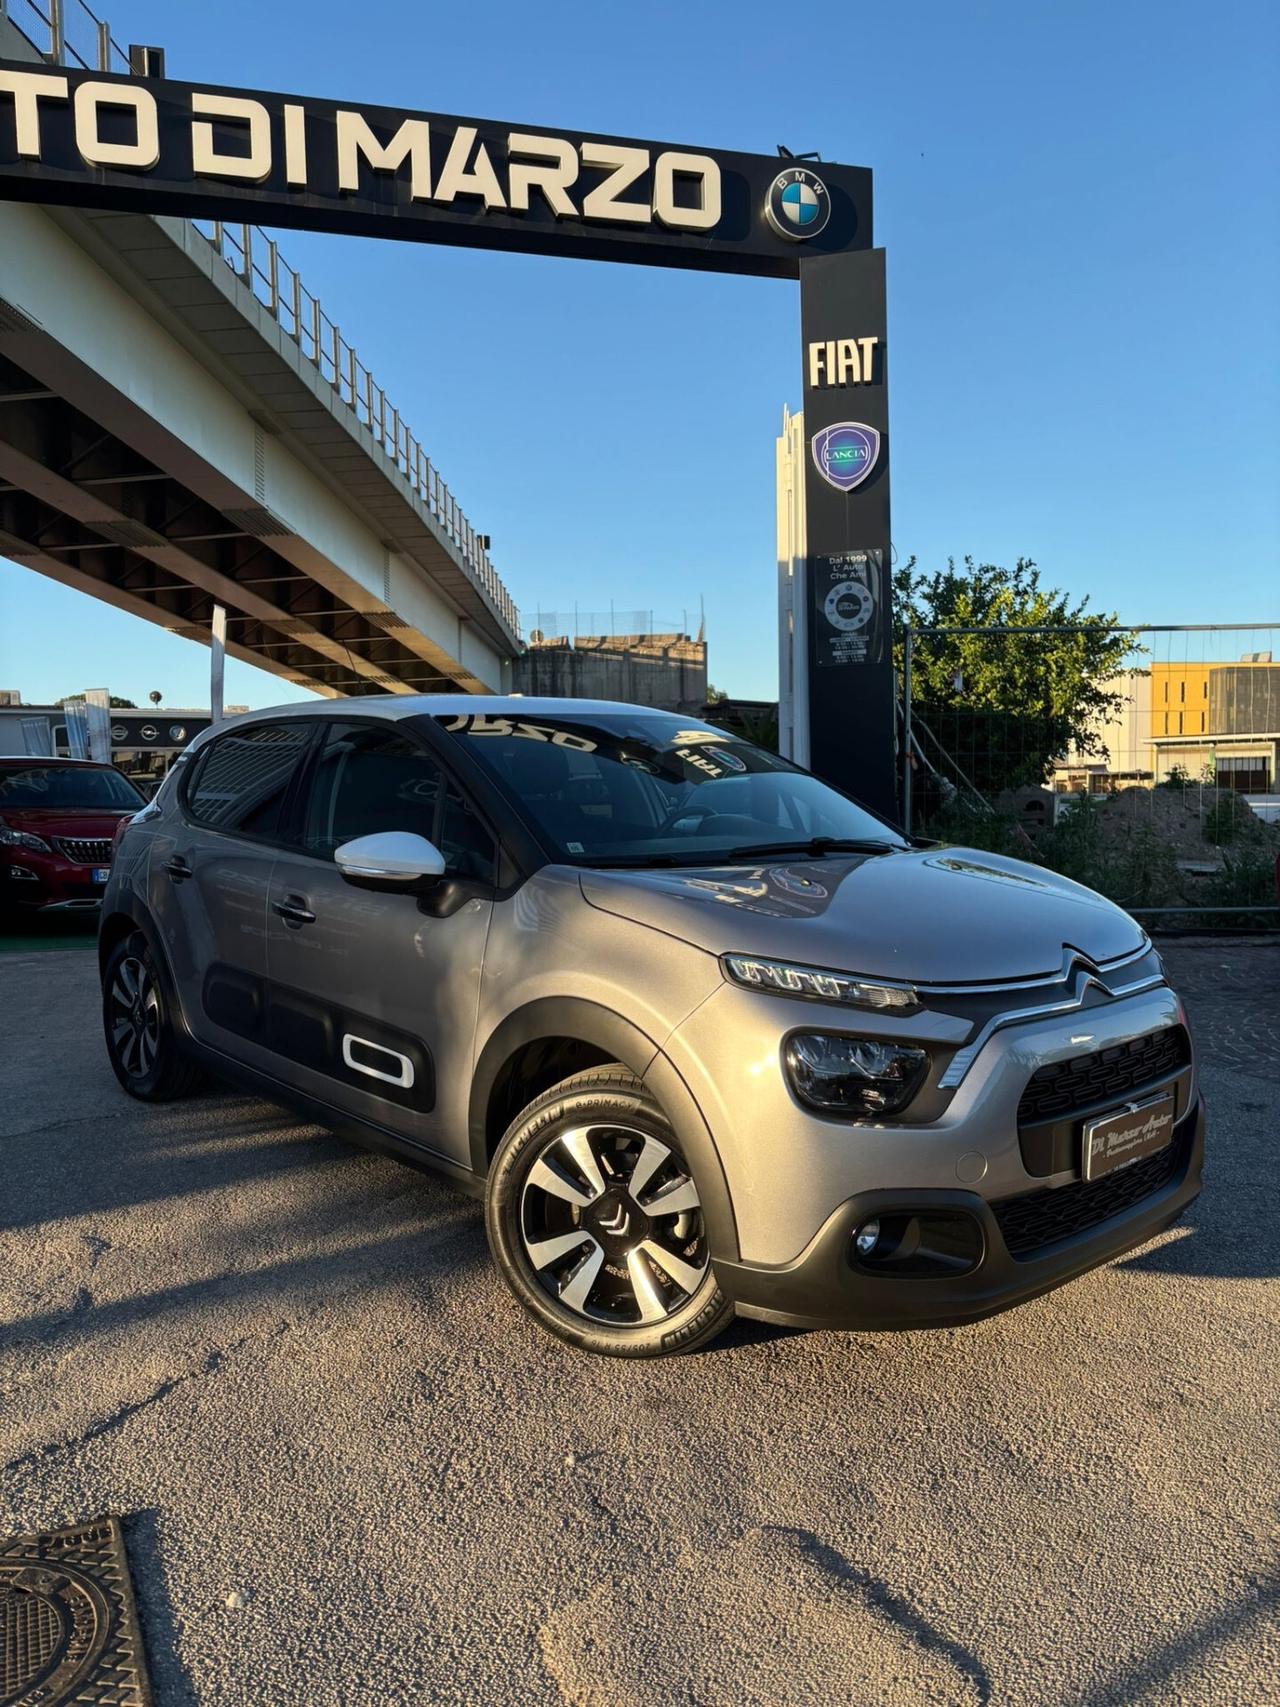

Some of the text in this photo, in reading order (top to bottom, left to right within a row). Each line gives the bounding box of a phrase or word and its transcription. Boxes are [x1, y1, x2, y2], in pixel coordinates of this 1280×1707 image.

[0, 70, 721, 229] TO DI MARZO
[777, 171, 824, 194] BMW
[809, 337, 878, 387] FIAT
[826, 448, 866, 460] LANCIA
[829, 554, 867, 564] Dal 1999
[843, 563, 863, 571] Auto
[830, 572, 847, 580] Che
[506, 1105, 563, 1169] MICHELIN
[664, 1291, 721, 1345] MICHELIN
